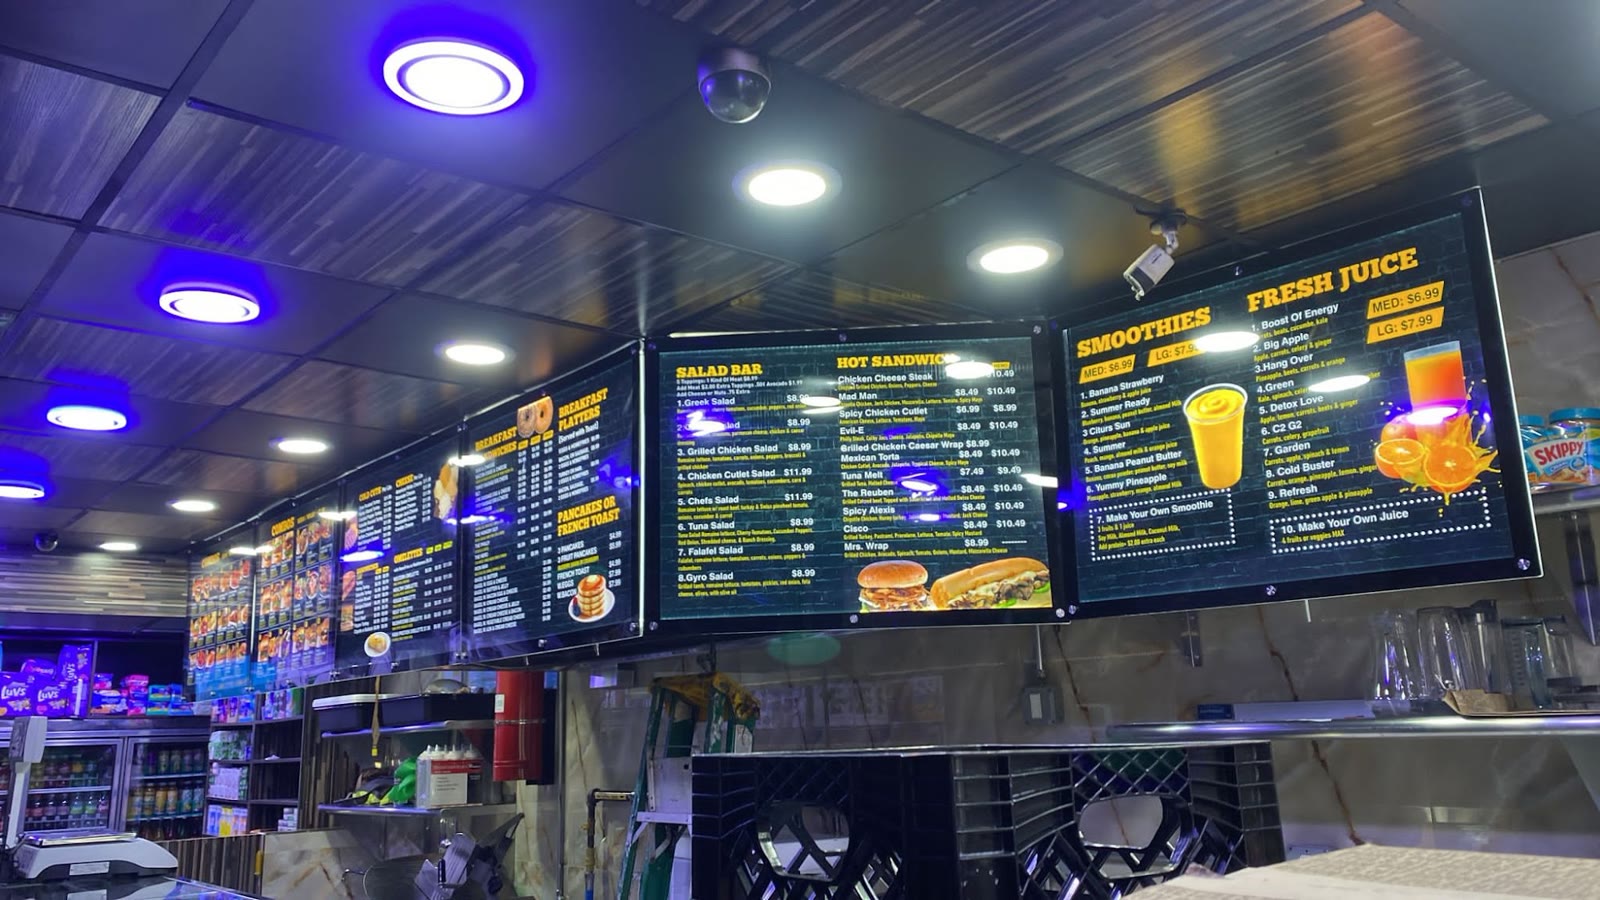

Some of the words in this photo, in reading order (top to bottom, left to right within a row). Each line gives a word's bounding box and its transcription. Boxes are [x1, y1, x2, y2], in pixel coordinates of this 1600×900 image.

[1247, 272, 1334, 312] FRESH
[1339, 247, 1418, 292] JUICE
[1372, 295, 1404, 314] MED:
[1407, 288, 1439, 304] $6.99
[1262, 316, 1289, 330] Boost
[1290, 312, 1302, 322] Of
[1304, 304, 1338, 318] Energy
[1076, 306, 1212, 358] SMOOTHIES
[1376, 322, 1398, 337] LG:
[1400, 314, 1432, 332] $7.99
[1253, 344, 1262, 352] 2.
[1264, 340, 1280, 351] Big
[1282, 332, 1310, 346] Apple
[837, 357, 868, 368] HOT
[1156, 350, 1172, 362] LG:
[1084, 366, 1107, 380] MED:
[1109, 359, 1132, 373] $6.99
[1254, 360, 1288, 373] 3.Hang
[1290, 354, 1313, 364] Over
[676, 365, 728, 378] SALAD
[731, 364, 762, 375] BAR
[838, 375, 872, 384] Chicken
[875, 374, 906, 383] Cheese
[909, 373, 933, 381] Steak
[955, 388, 979, 396] $8.49
[987, 387, 1016, 395] $10.49
[1089, 385, 1118, 398] Banana
[1120, 374, 1164, 390] Strawberry
[1256, 380, 1294, 393] 4.Green
[559, 387, 608, 418] BREAKFAST
[677, 398, 709, 407] 1.Greek
[1090, 404, 1123, 416] Summer
[1124, 397, 1150, 408] Ready
[1258, 406, 1268, 414] 5.
[1270, 402, 1298, 412] Detox
[1300, 395, 1324, 406] Love
[839, 410, 862, 418] Spicy
[865, 408, 900, 416] Chicken
[956, 405, 980, 414] $6.99
[993, 404, 1017, 412] $8.99
[559, 405, 600, 432] PLATTERS
[787, 419, 810, 427] $8.99
[840, 427, 864, 435] Evil-E
[957, 422, 981, 430] $8.49
[989, 421, 1018, 430] $10.49
[1089, 424, 1113, 435] Citurs
[1114, 422, 1131, 430] Sun
[1261, 427, 1270, 436] 6.
[1272, 424, 1286, 433] C2
[1288, 420, 1302, 430] G2
[475, 426, 517, 452] BREAKFAST
[840, 444, 868, 452] Grilled
[871, 443, 906, 451] Chicken
[908, 441, 938, 449] Caesar
[941, 440, 963, 450] Wrap
[966, 440, 989, 448] $8.99
[687, 447, 716, 456] Grilled
[718, 445, 752, 454] Chicken
[754, 444, 778, 452] Salad
[788, 443, 811, 451] $8.99
[958, 450, 983, 458] $8.49
[991, 449, 1020, 457] $10.49
[1092, 442, 1126, 453] Summer
[1263, 448, 1273, 457] 7.
[1274, 442, 1311, 454] Garden
[1534, 441, 1583, 465] SKIPPY
[1094, 460, 1124, 472] Banana
[1125, 456, 1154, 467] Peanut
[1156, 450, 1182, 461] Butter
[688, 471, 722, 480] Chicken
[724, 470, 749, 479] Cutlet
[751, 469, 776, 478] Salad
[784, 468, 812, 476] $11.99
[842, 472, 862, 480] Tuna
[864, 471, 883, 479] Melt
[959, 468, 984, 476] $7.49
[998, 466, 1021, 474] $9.49
[1266, 470, 1275, 478] 8.
[1277, 465, 1300, 476] Cold
[1302, 460, 1335, 472] Buster
[1096, 480, 1124, 492] Yummy
[1126, 473, 1167, 487] Pineapple
[842, 489, 858, 497] The
[860, 488, 894, 497] Reuben
[961, 485, 985, 493] $8.49
[993, 484, 1023, 492] $10.49
[1268, 491, 1277, 499] 9.
[1280, 485, 1318, 498] Refresh
[688, 497, 713, 505] Chefs
[715, 495, 739, 504] Salad
[784, 493, 813, 501] $11.99
[558, 499, 602, 524] PANCAKES
[604, 496, 616, 508] OR
[843, 507, 866, 517] Spicy
[869, 506, 895, 514] Alexis
[962, 503, 986, 511] $8.49
[995, 502, 1024, 510] $10.49
[1096, 516, 1104, 524] 7.
[1106, 513, 1128, 523] Make
[1130, 510, 1148, 519] Your
[1150, 506, 1170, 516] Own
[1171, 500, 1213, 513] Smoothie
[558, 517, 589, 536] FRENCH
[591, 508, 620, 527] TOAST
[710, 521, 734, 529] Salad
[790, 518, 813, 526] $8.99
[843, 525, 868, 533] Cisco
[963, 521, 988, 529] $8.49
[996, 520, 1026, 528] $10.49
[1282, 526, 1296, 534] 10.
[1298, 521, 1325, 532] Make
[1327, 517, 1350, 528] Your
[1353, 514, 1377, 524] Own
[1379, 510, 1409, 521] Juice
[688, 547, 717, 555] Falafel
[718, 546, 743, 554] Salad
[791, 543, 815, 552] $8.99
[844, 542, 863, 551] Mrs.
[865, 542, 889, 551] Wrap
[964, 538, 989, 547] $8.99
[678, 573, 707, 583] 8.Gyro
[709, 572, 733, 580] Salad
[791, 569, 815, 577] $8.99
